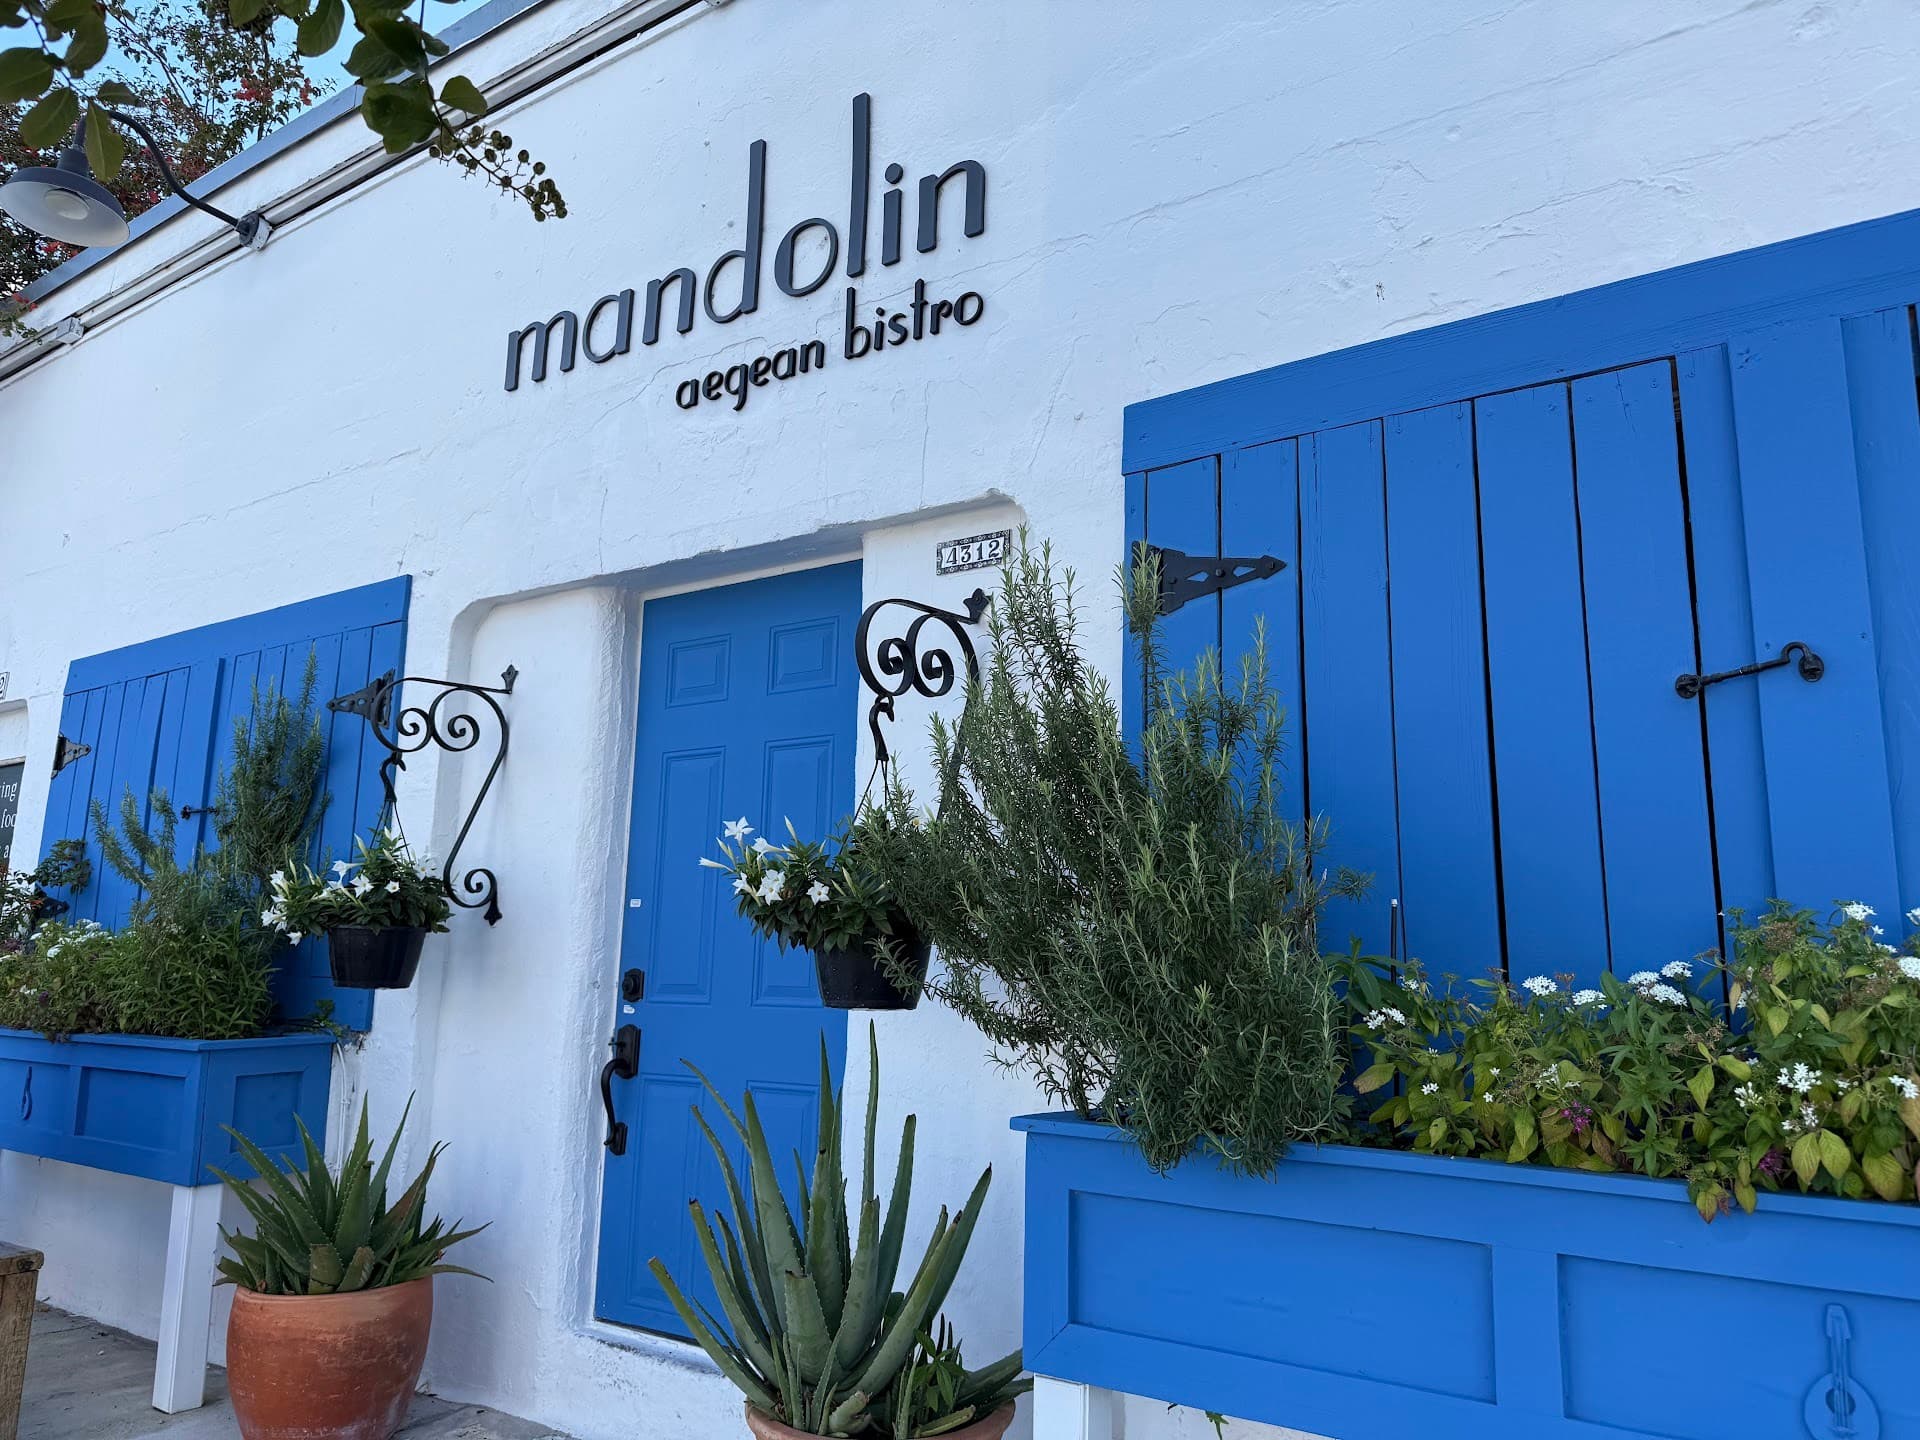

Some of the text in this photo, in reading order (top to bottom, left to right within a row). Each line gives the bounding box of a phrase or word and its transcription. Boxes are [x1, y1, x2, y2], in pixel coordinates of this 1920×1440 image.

[504, 92, 986, 392] mandolin
[675, 278, 984, 411] aegean bistro
[946, 539, 1000, 565] 4312
[0, 782, 18, 802] ing
